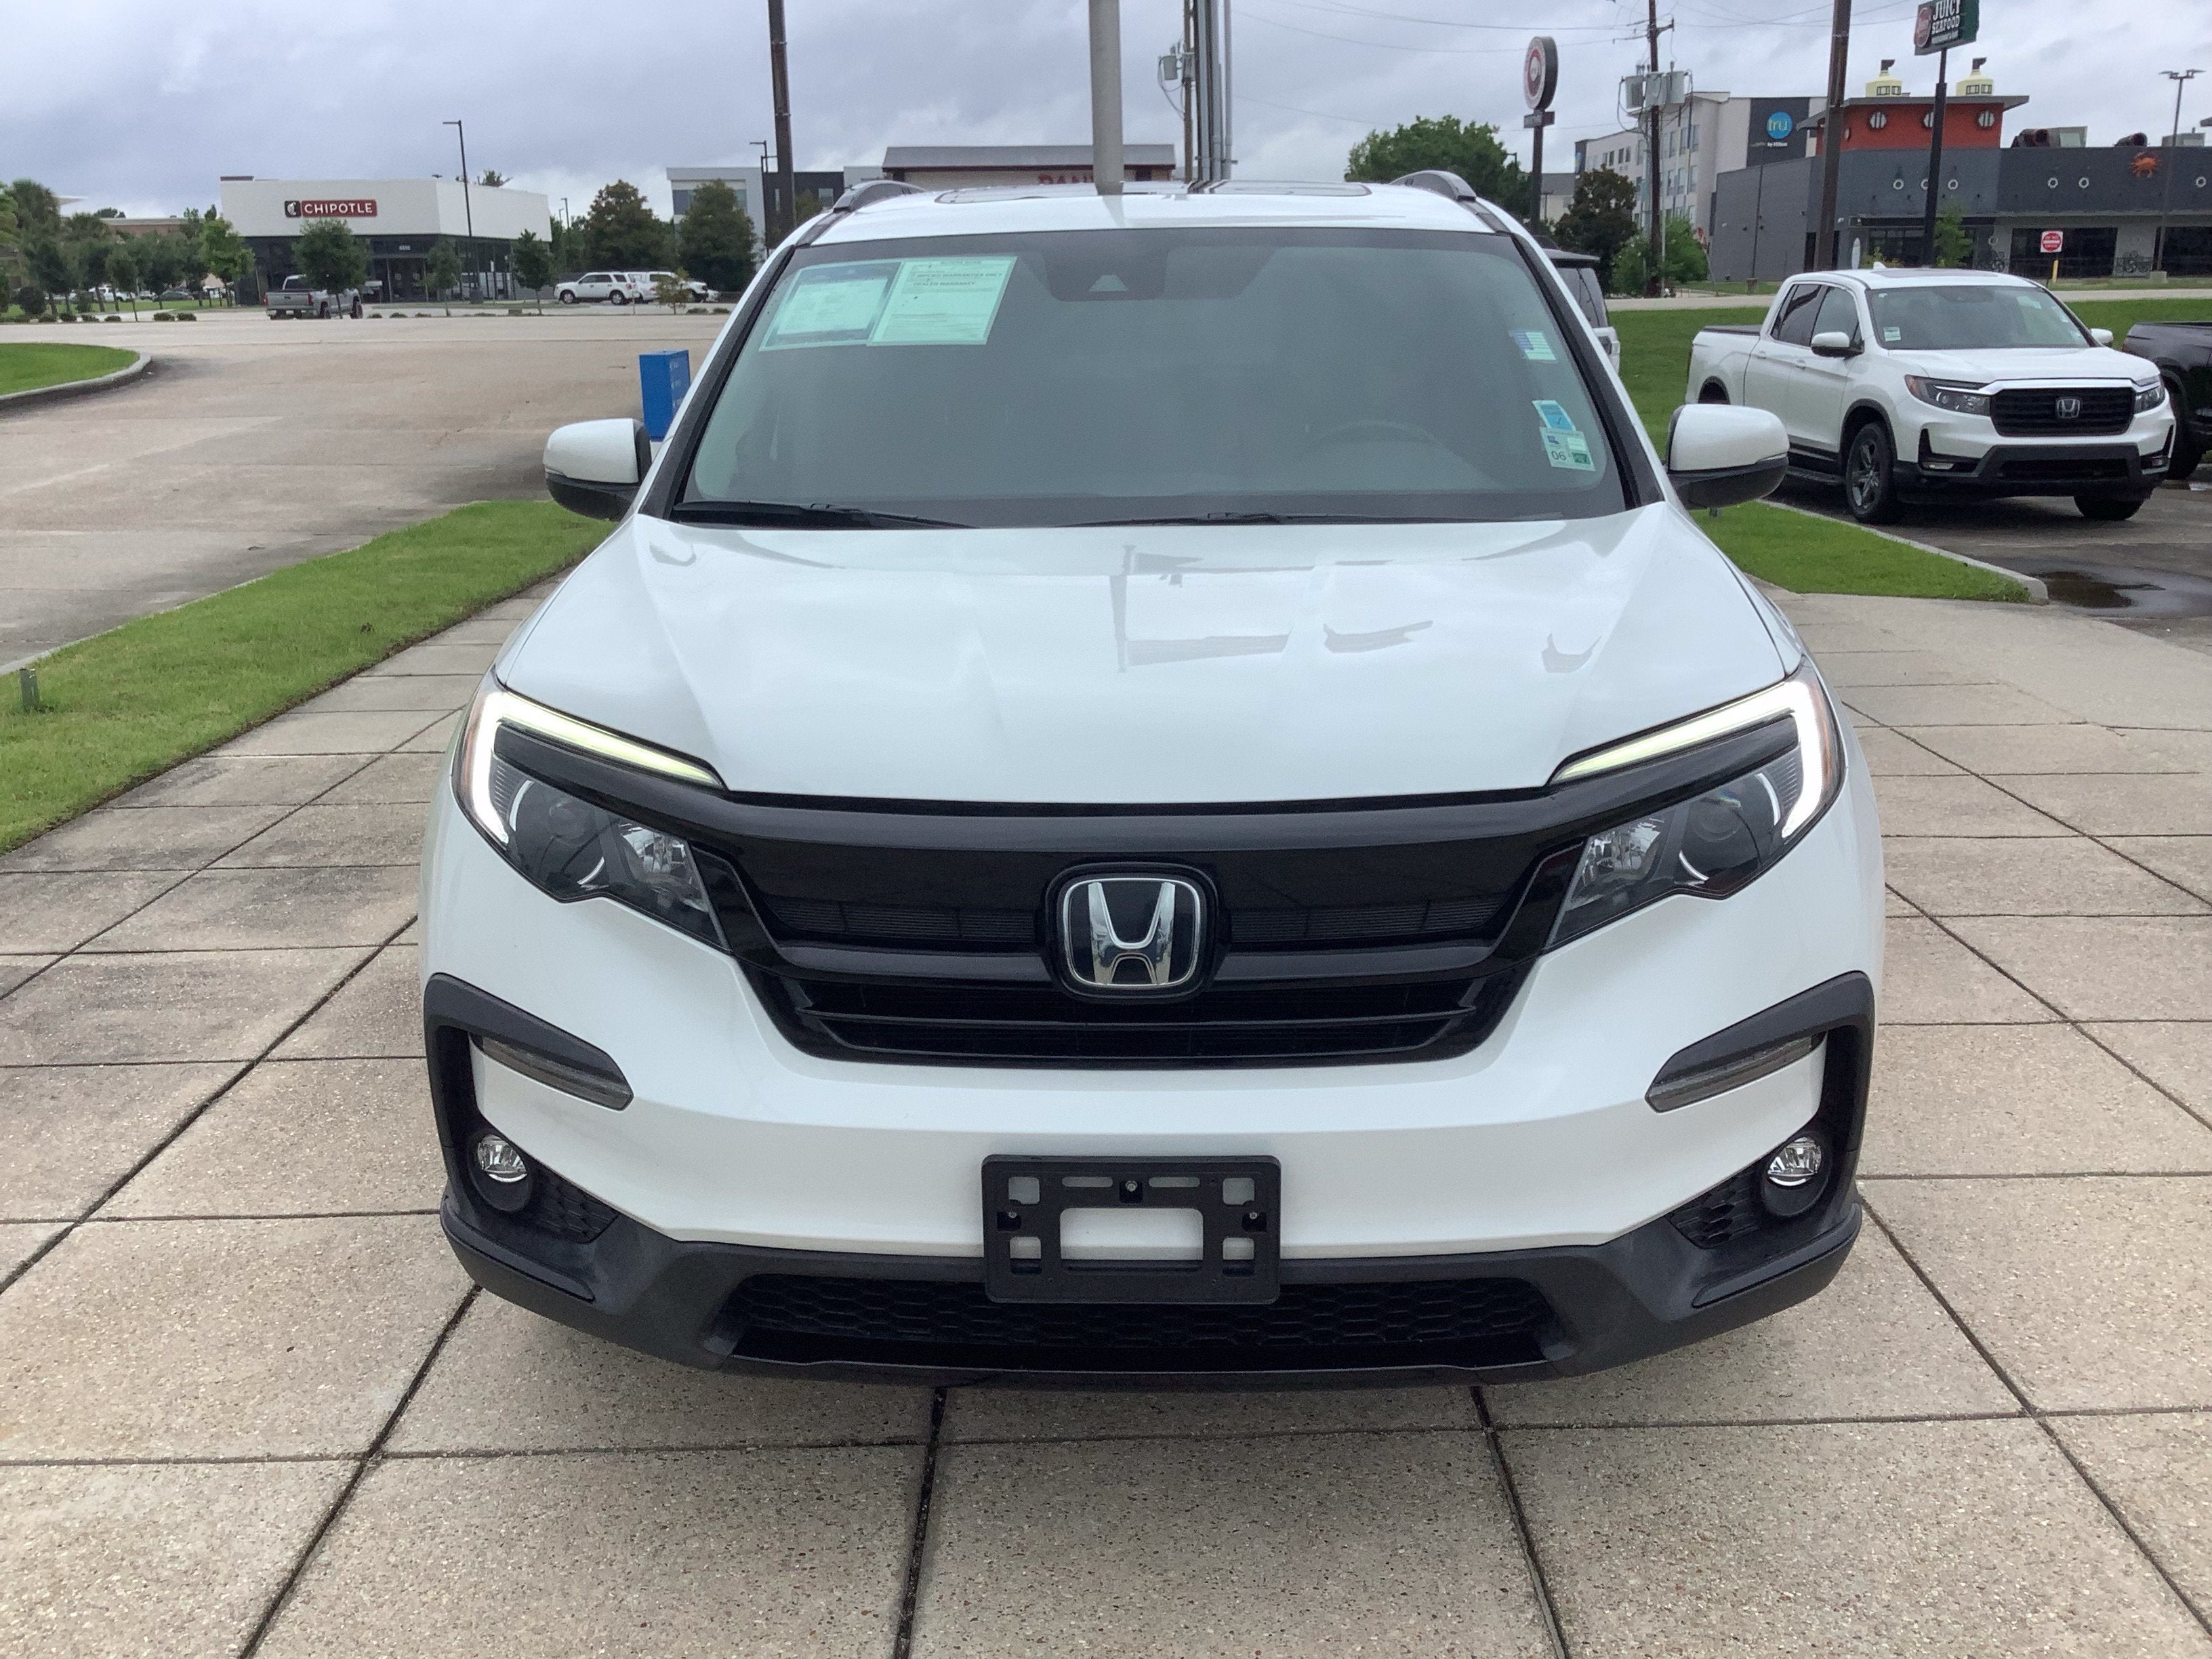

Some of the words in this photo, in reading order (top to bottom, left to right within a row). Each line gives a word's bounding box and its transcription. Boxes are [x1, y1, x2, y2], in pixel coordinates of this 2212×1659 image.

[1932, 15, 1960, 35] SEAFOOD
[304, 203, 373, 213] CHIPOTLE
[1551, 450, 1566, 460] 06
